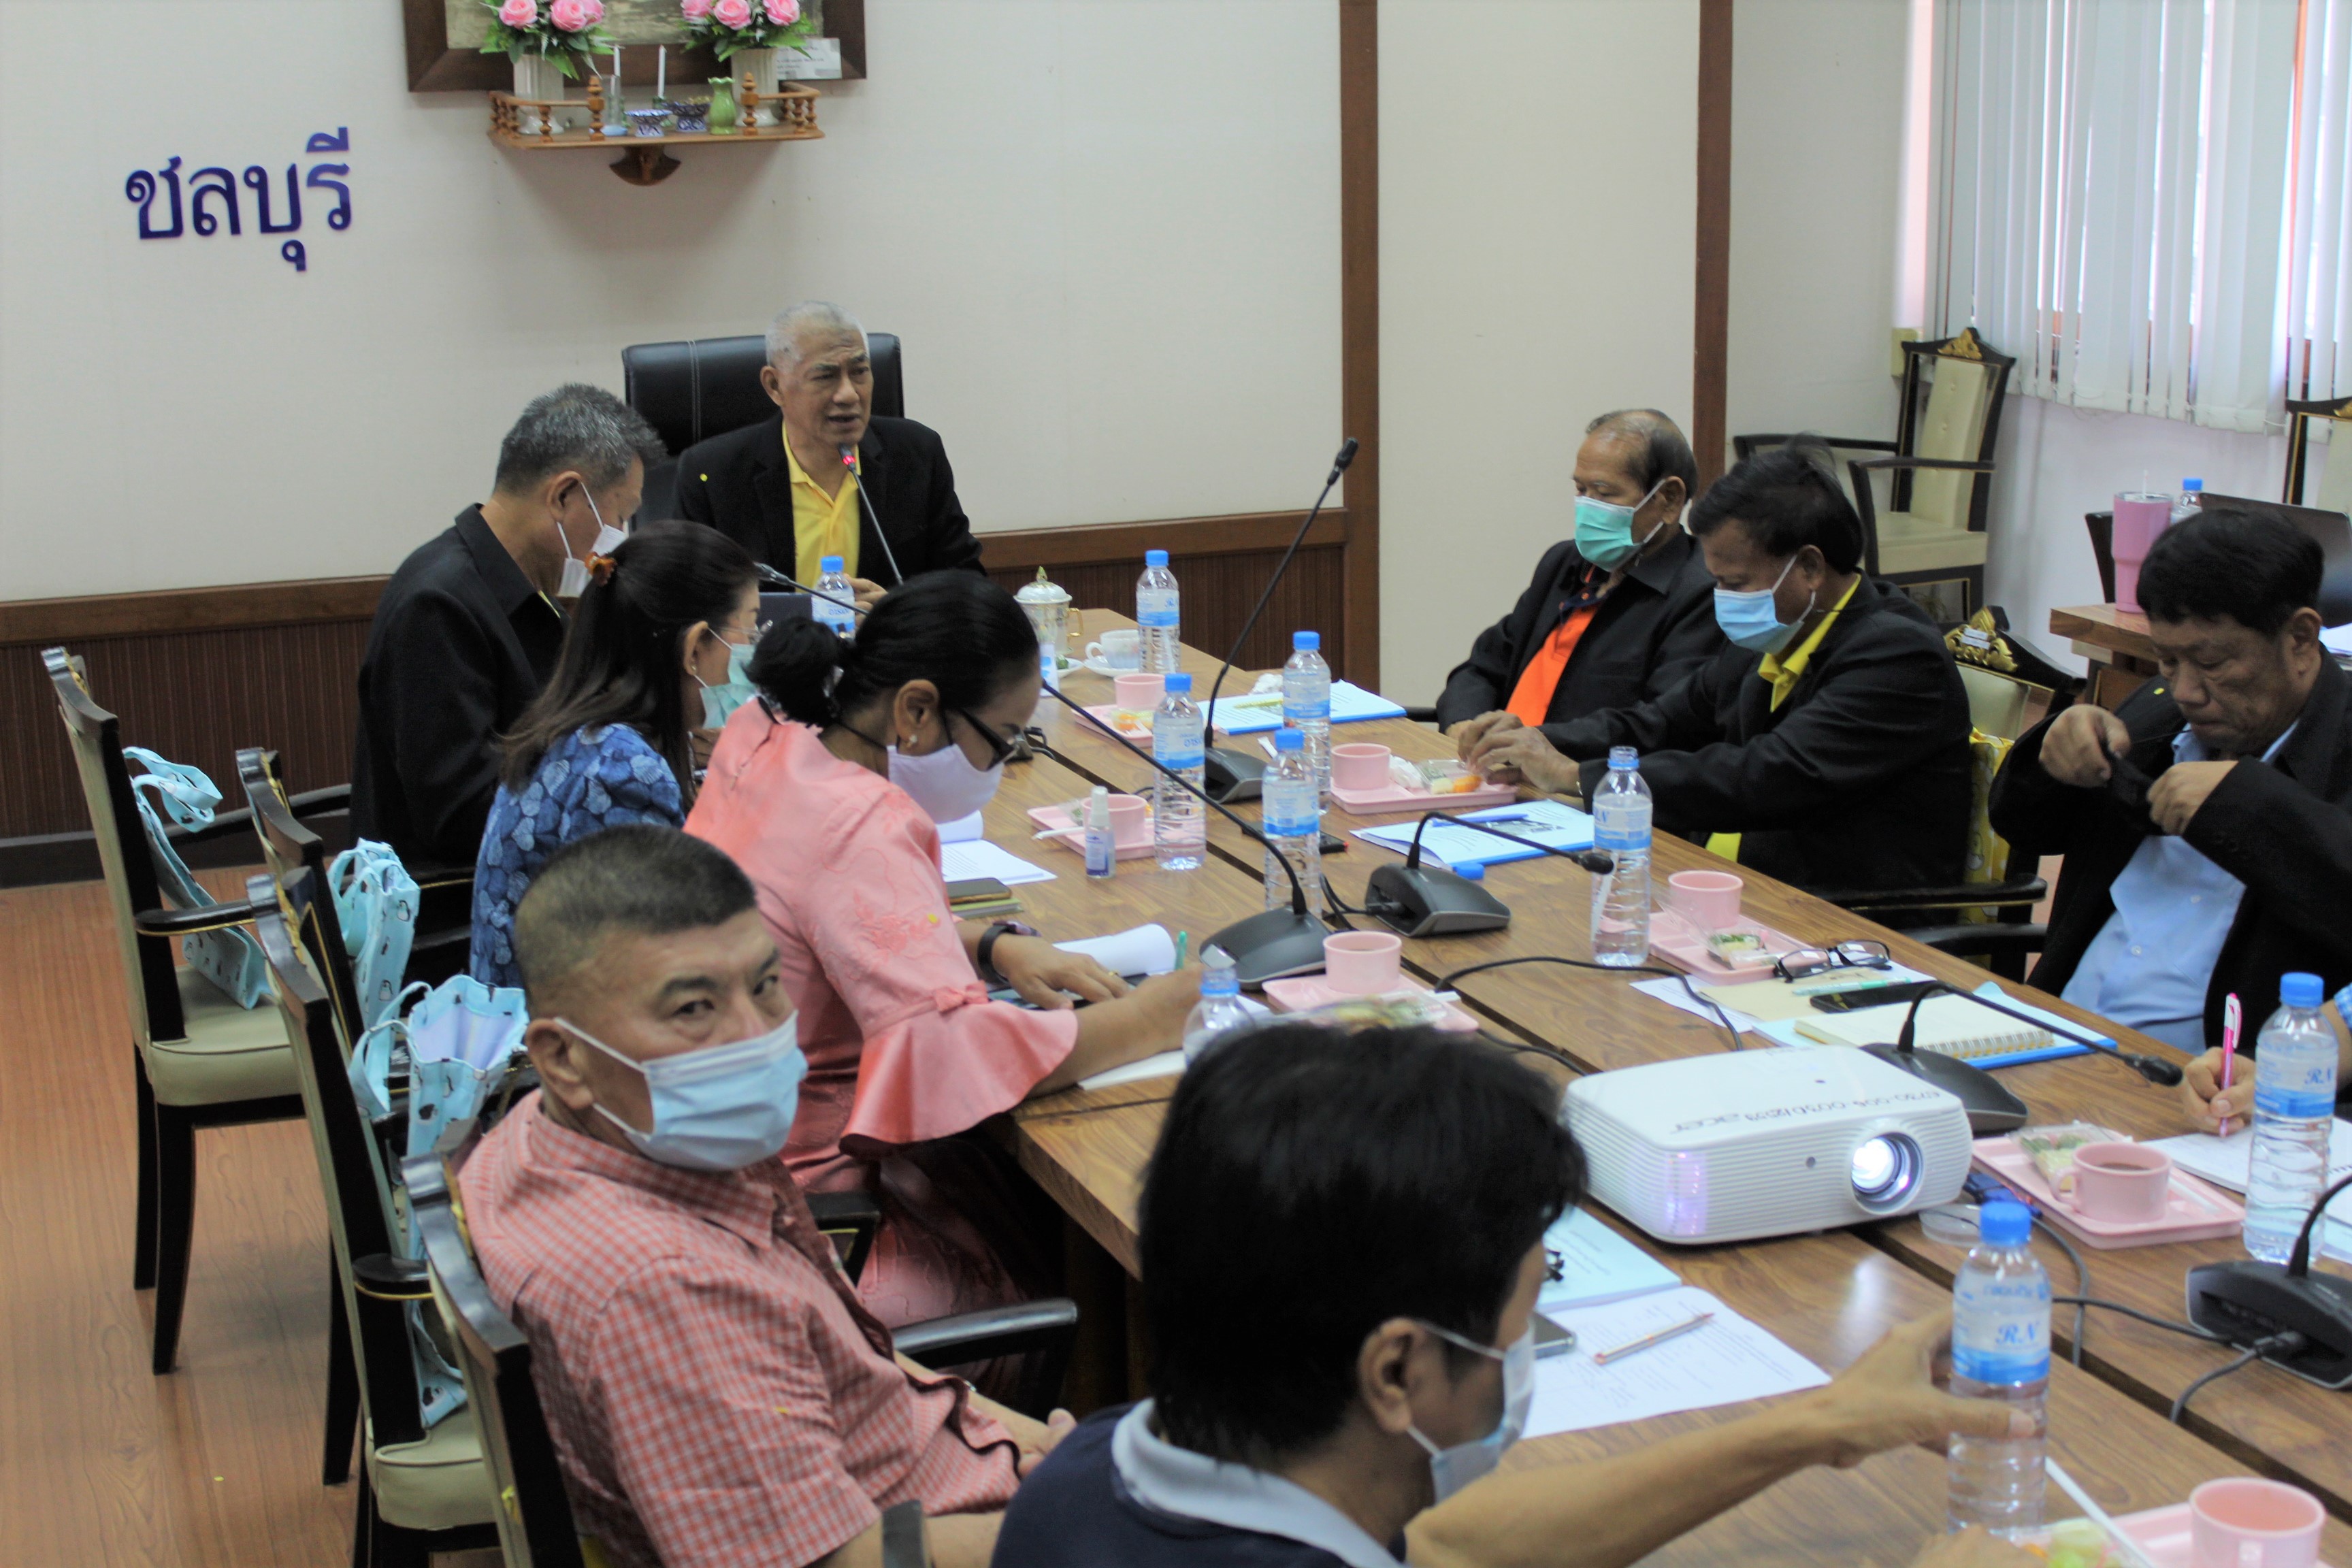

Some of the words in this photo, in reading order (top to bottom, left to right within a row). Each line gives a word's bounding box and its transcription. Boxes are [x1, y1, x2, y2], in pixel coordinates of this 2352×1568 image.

[125, 127, 352, 272] ชลบุรี
[1669, 1112, 1741, 1134] acer
